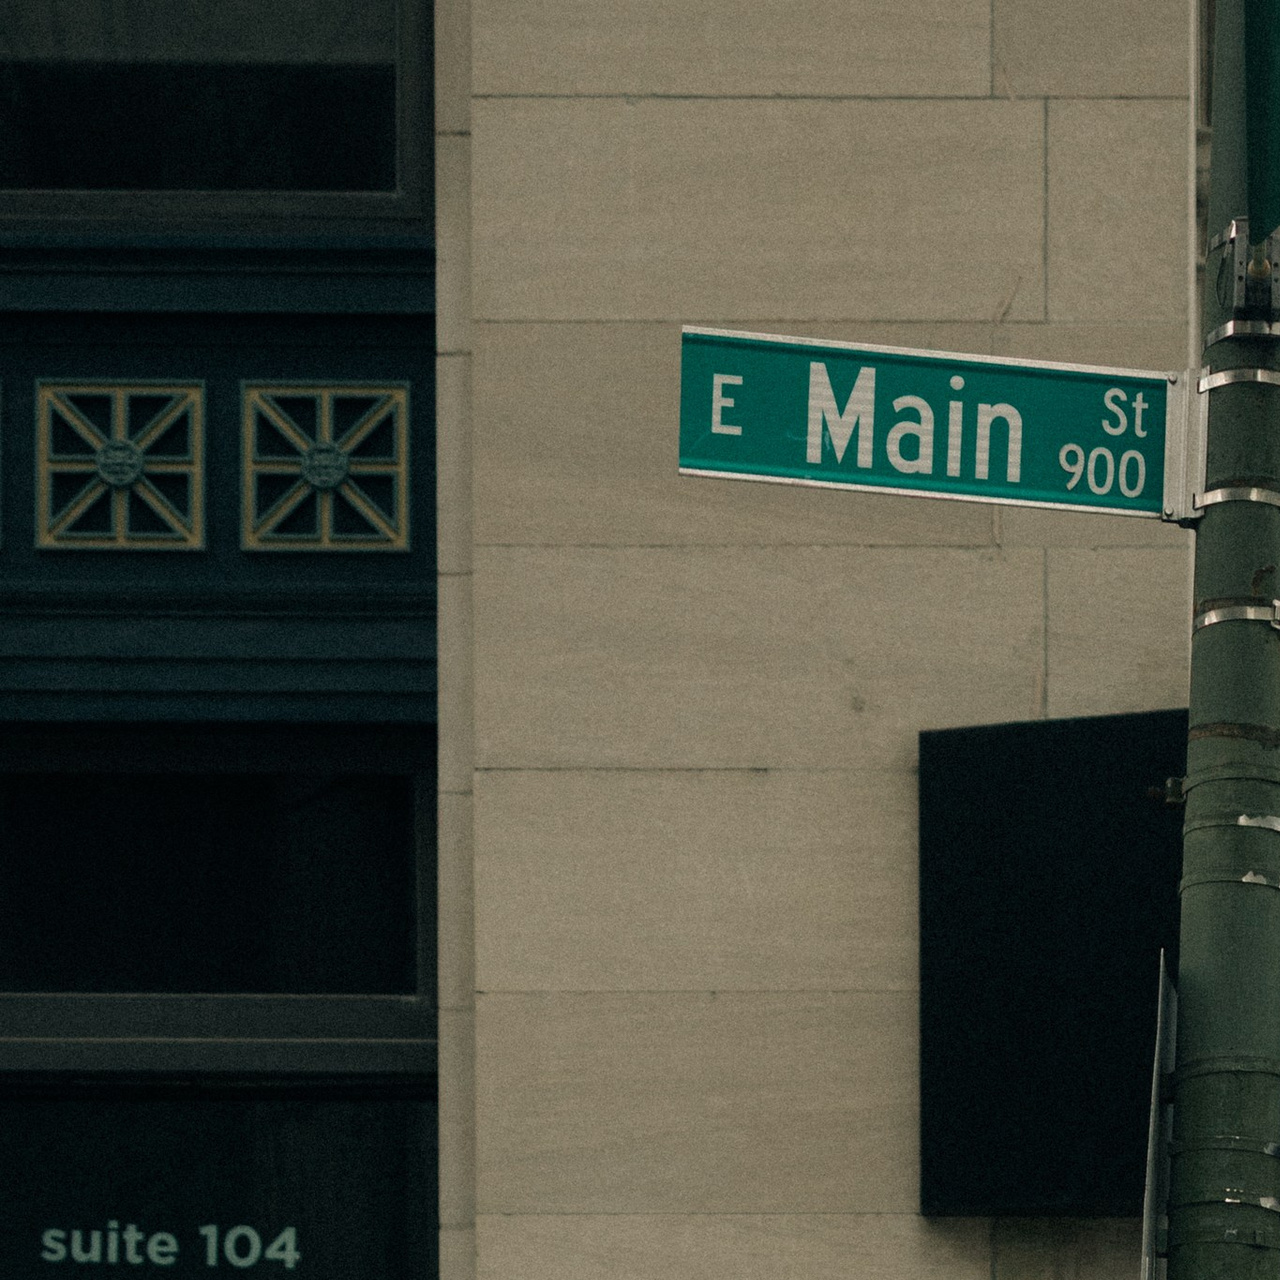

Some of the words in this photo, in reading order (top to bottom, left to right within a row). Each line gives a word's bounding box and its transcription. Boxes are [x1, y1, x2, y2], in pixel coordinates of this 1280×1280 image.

[711, 373, 744, 436] E
[806, 361, 1023, 483] Main
[1101, 387, 1149, 438] St
[1058, 442, 1147, 498] 900
[40, 1219, 180, 1266] suite
[199, 1224, 301, 1269] 104
